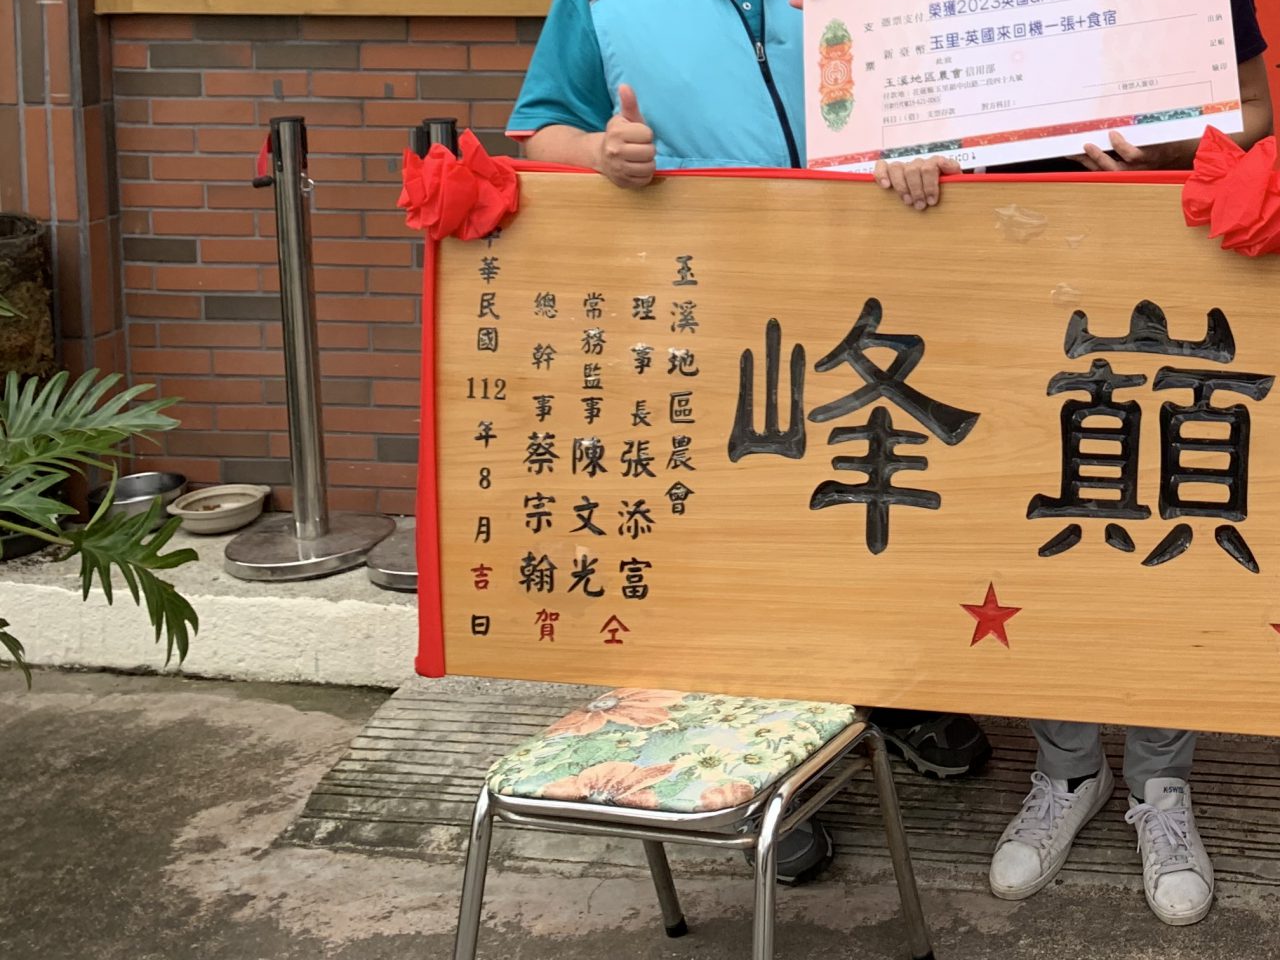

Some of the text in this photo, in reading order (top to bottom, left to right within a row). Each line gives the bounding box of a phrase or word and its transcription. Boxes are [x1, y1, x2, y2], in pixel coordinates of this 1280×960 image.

[664, 254, 701, 516] 玉溪地區農會
